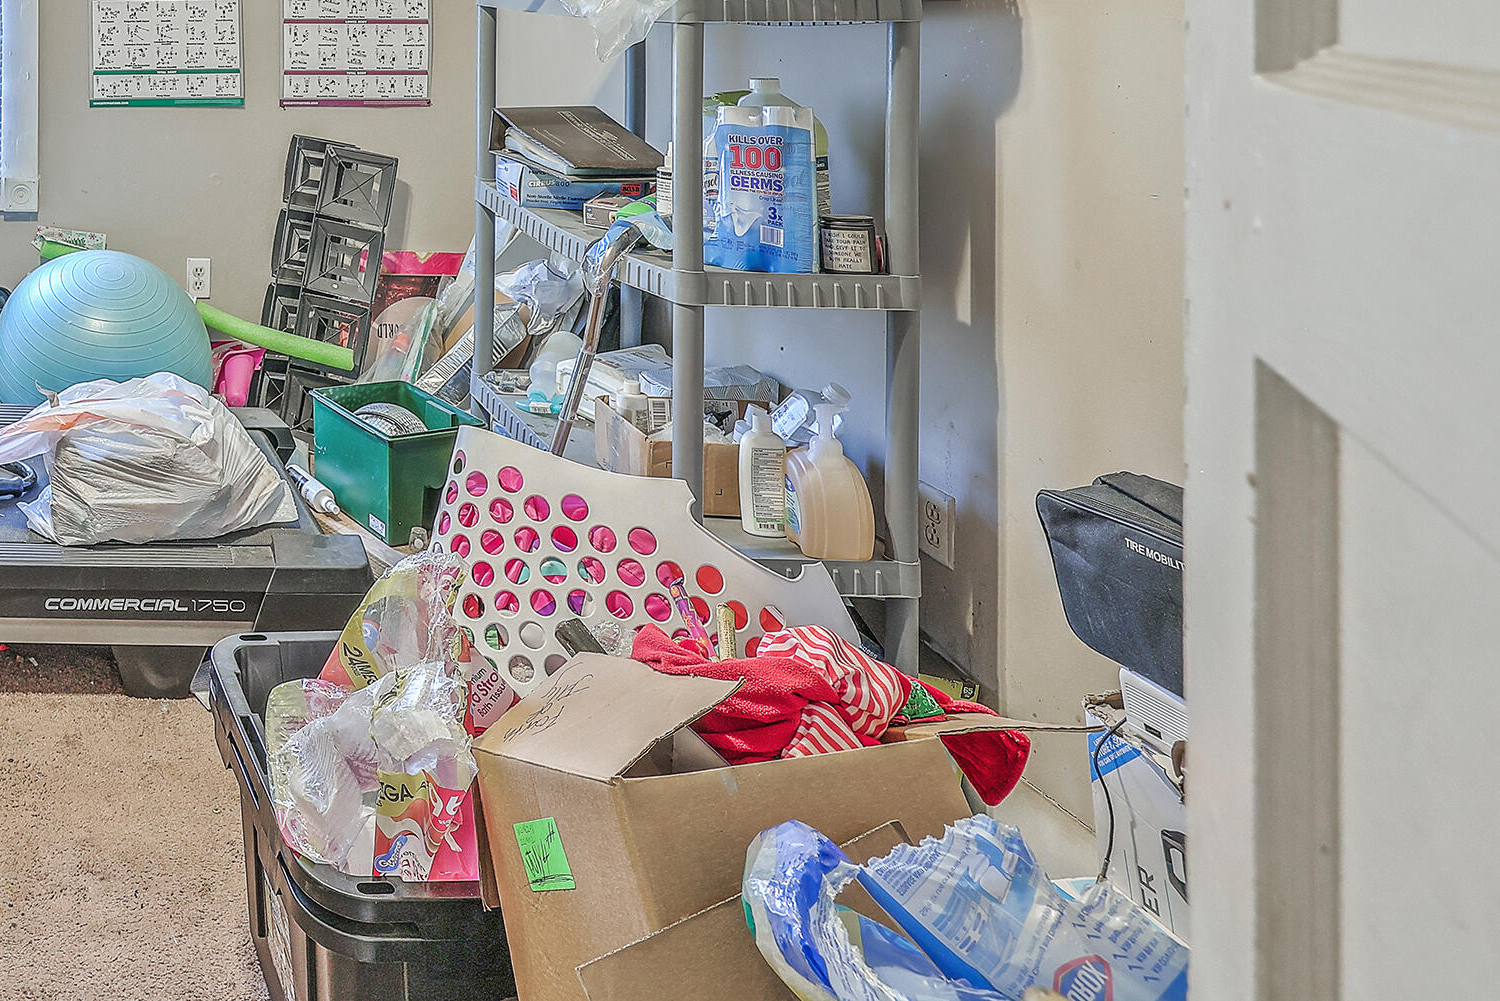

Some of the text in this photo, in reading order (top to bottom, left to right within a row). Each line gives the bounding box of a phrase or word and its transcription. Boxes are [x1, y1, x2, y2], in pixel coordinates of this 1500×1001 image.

[728, 134, 783, 146] KILLS OVER
[729, 145, 782, 171] 100
[730, 169, 783, 180] ILLNESS CAUSING
[730, 175, 783, 192] GERMS
[1124, 537, 1185, 572] TIRE MOBILIT
[44, 597, 246, 613] COMMERCIAL 1750
[476, 699, 493, 717] Bath
